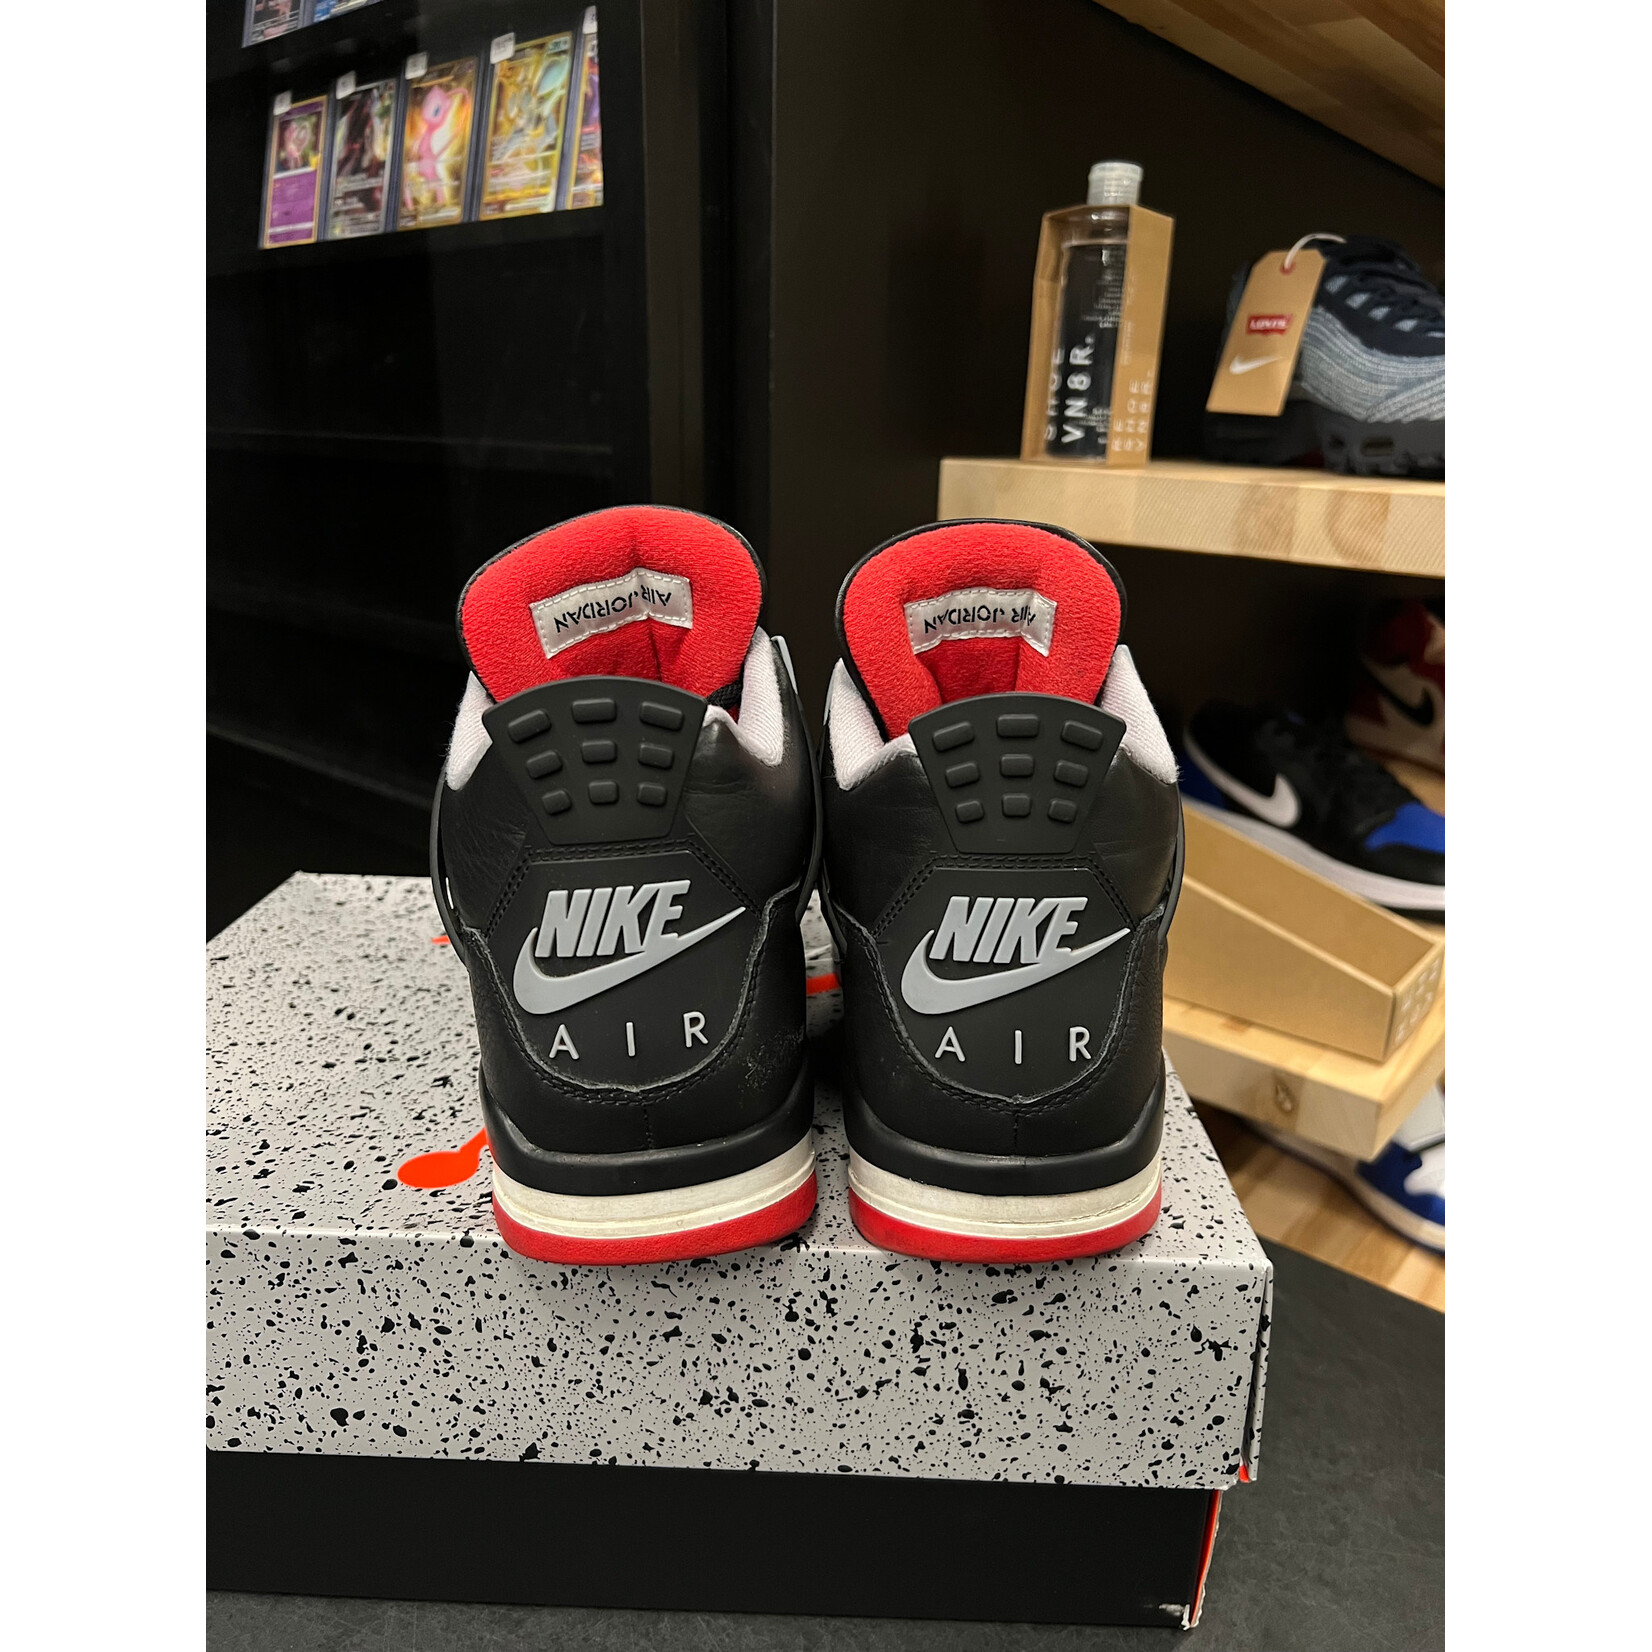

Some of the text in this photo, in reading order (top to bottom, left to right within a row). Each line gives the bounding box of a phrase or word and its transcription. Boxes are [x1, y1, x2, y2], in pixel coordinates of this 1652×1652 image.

[553, 584, 673, 634] AIR JORDAN
[924, 604, 1037, 634] AIR JORDAN
[534, 879, 690, 958] NIKE
[928, 896, 1089, 964] NIKE
[548, 1011, 709, 1060] AIR
[934, 1026, 1092, 1065] AIR
